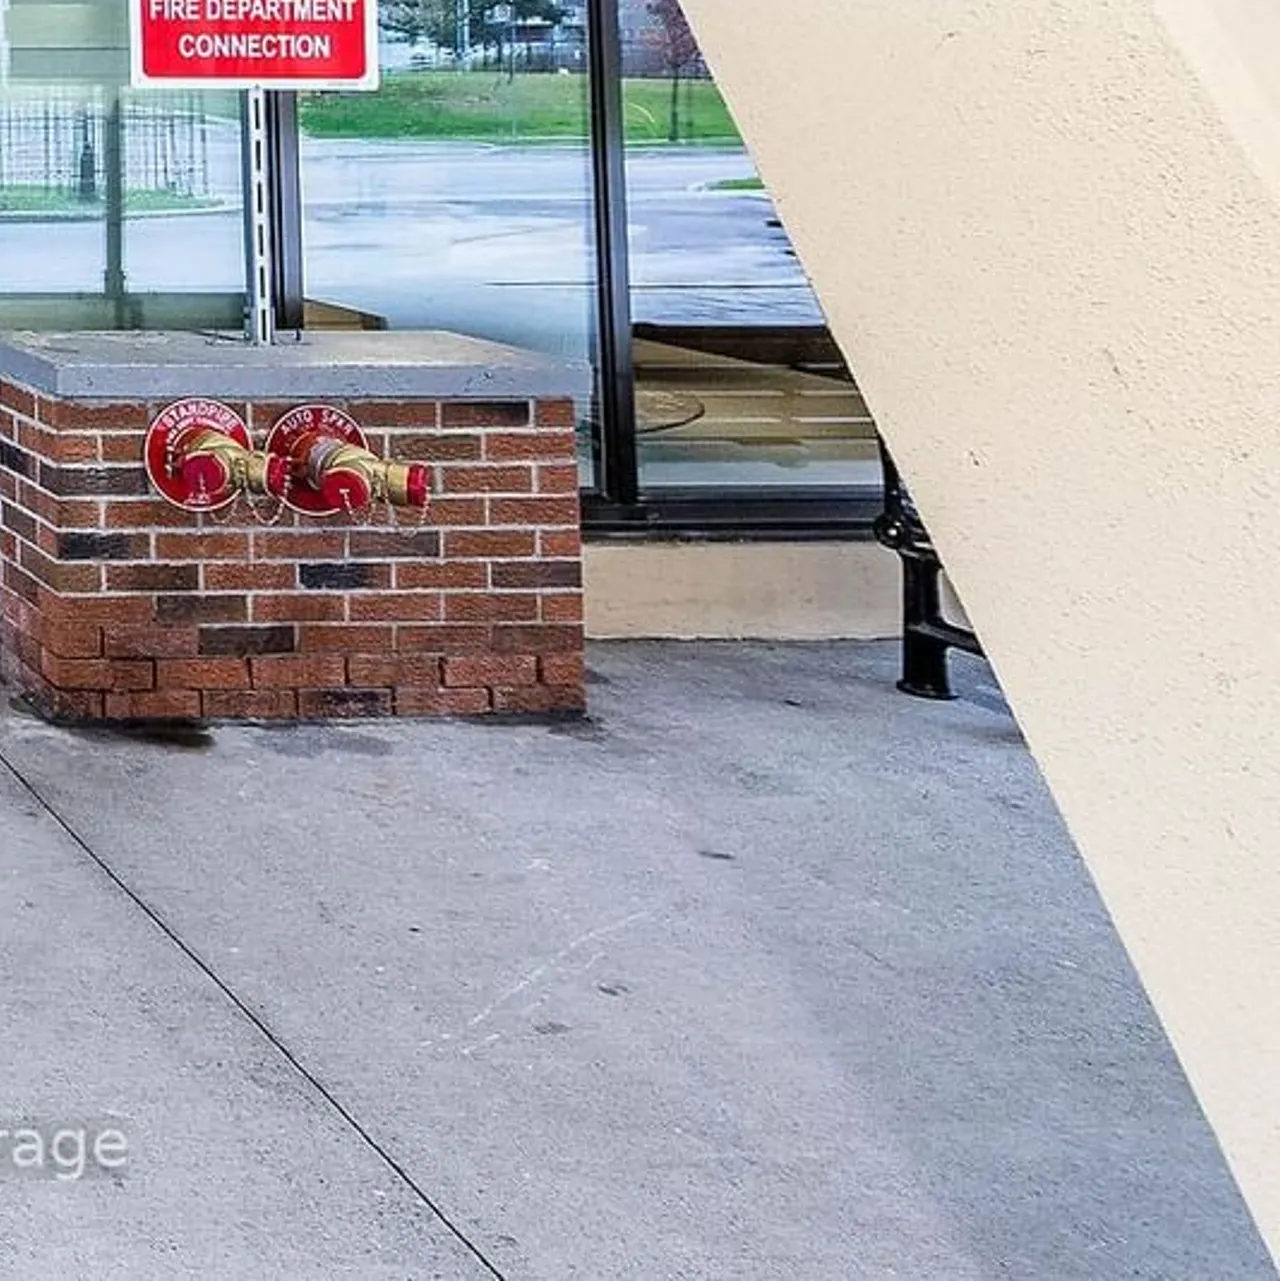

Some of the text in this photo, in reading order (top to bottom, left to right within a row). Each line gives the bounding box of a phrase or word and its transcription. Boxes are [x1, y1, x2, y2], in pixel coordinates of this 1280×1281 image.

[178, 33, 331, 59] CONNECTION
[161, 402, 238, 431] STANDPIPE
[280, 409, 314, 435] AUTO
